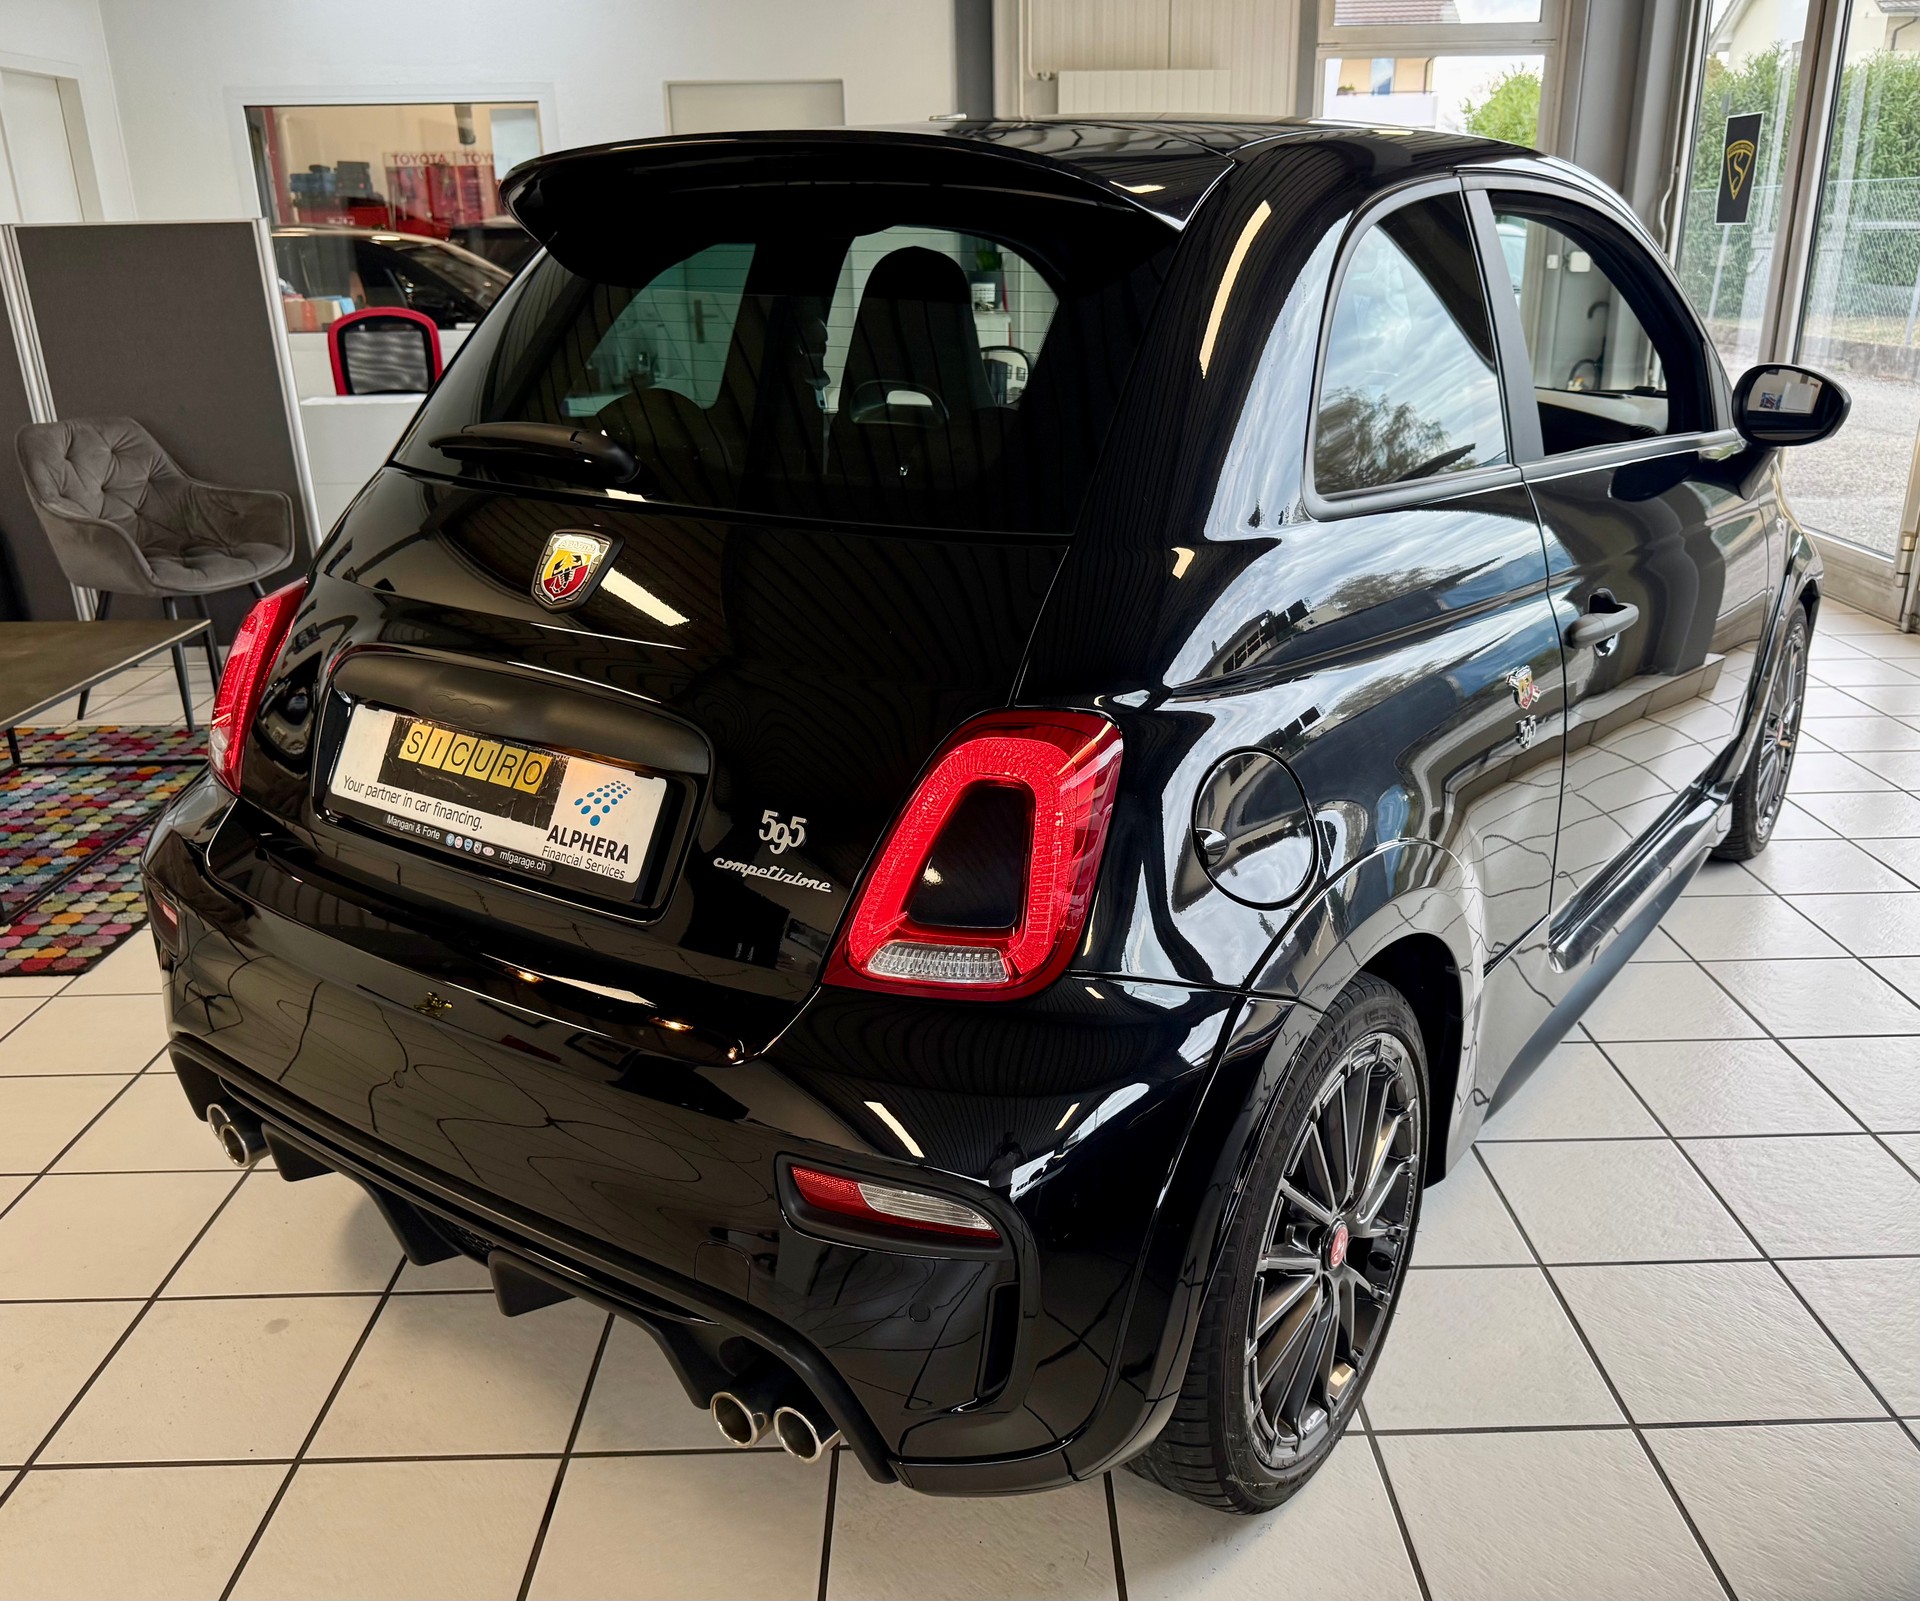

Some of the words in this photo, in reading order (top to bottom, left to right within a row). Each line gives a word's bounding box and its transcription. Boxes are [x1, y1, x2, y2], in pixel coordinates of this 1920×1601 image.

[392, 153, 446, 165] TOYOTA
[1515, 714, 1537, 750] 595
[407, 731, 543, 785] SICURO
[343, 775, 365, 793] Your
[364, 784, 402, 804] partner
[402, 793, 413, 808] in
[414, 800, 432, 813] car
[433, 802, 483, 831] financing.
[386, 814, 415, 832] Mangani
[415, 824, 421, 834] &
[422, 827, 441, 840] Forte
[546, 824, 629, 865] ALPHERA
[758, 809, 807, 854] 595
[499, 851, 547, 872] mfgarage.ch
[541, 845, 584, 867] Financial
[584, 858, 626, 880] Services
[713, 857, 832, 893] competizione
[1284, 1047, 1332, 1136] MICHELIN
